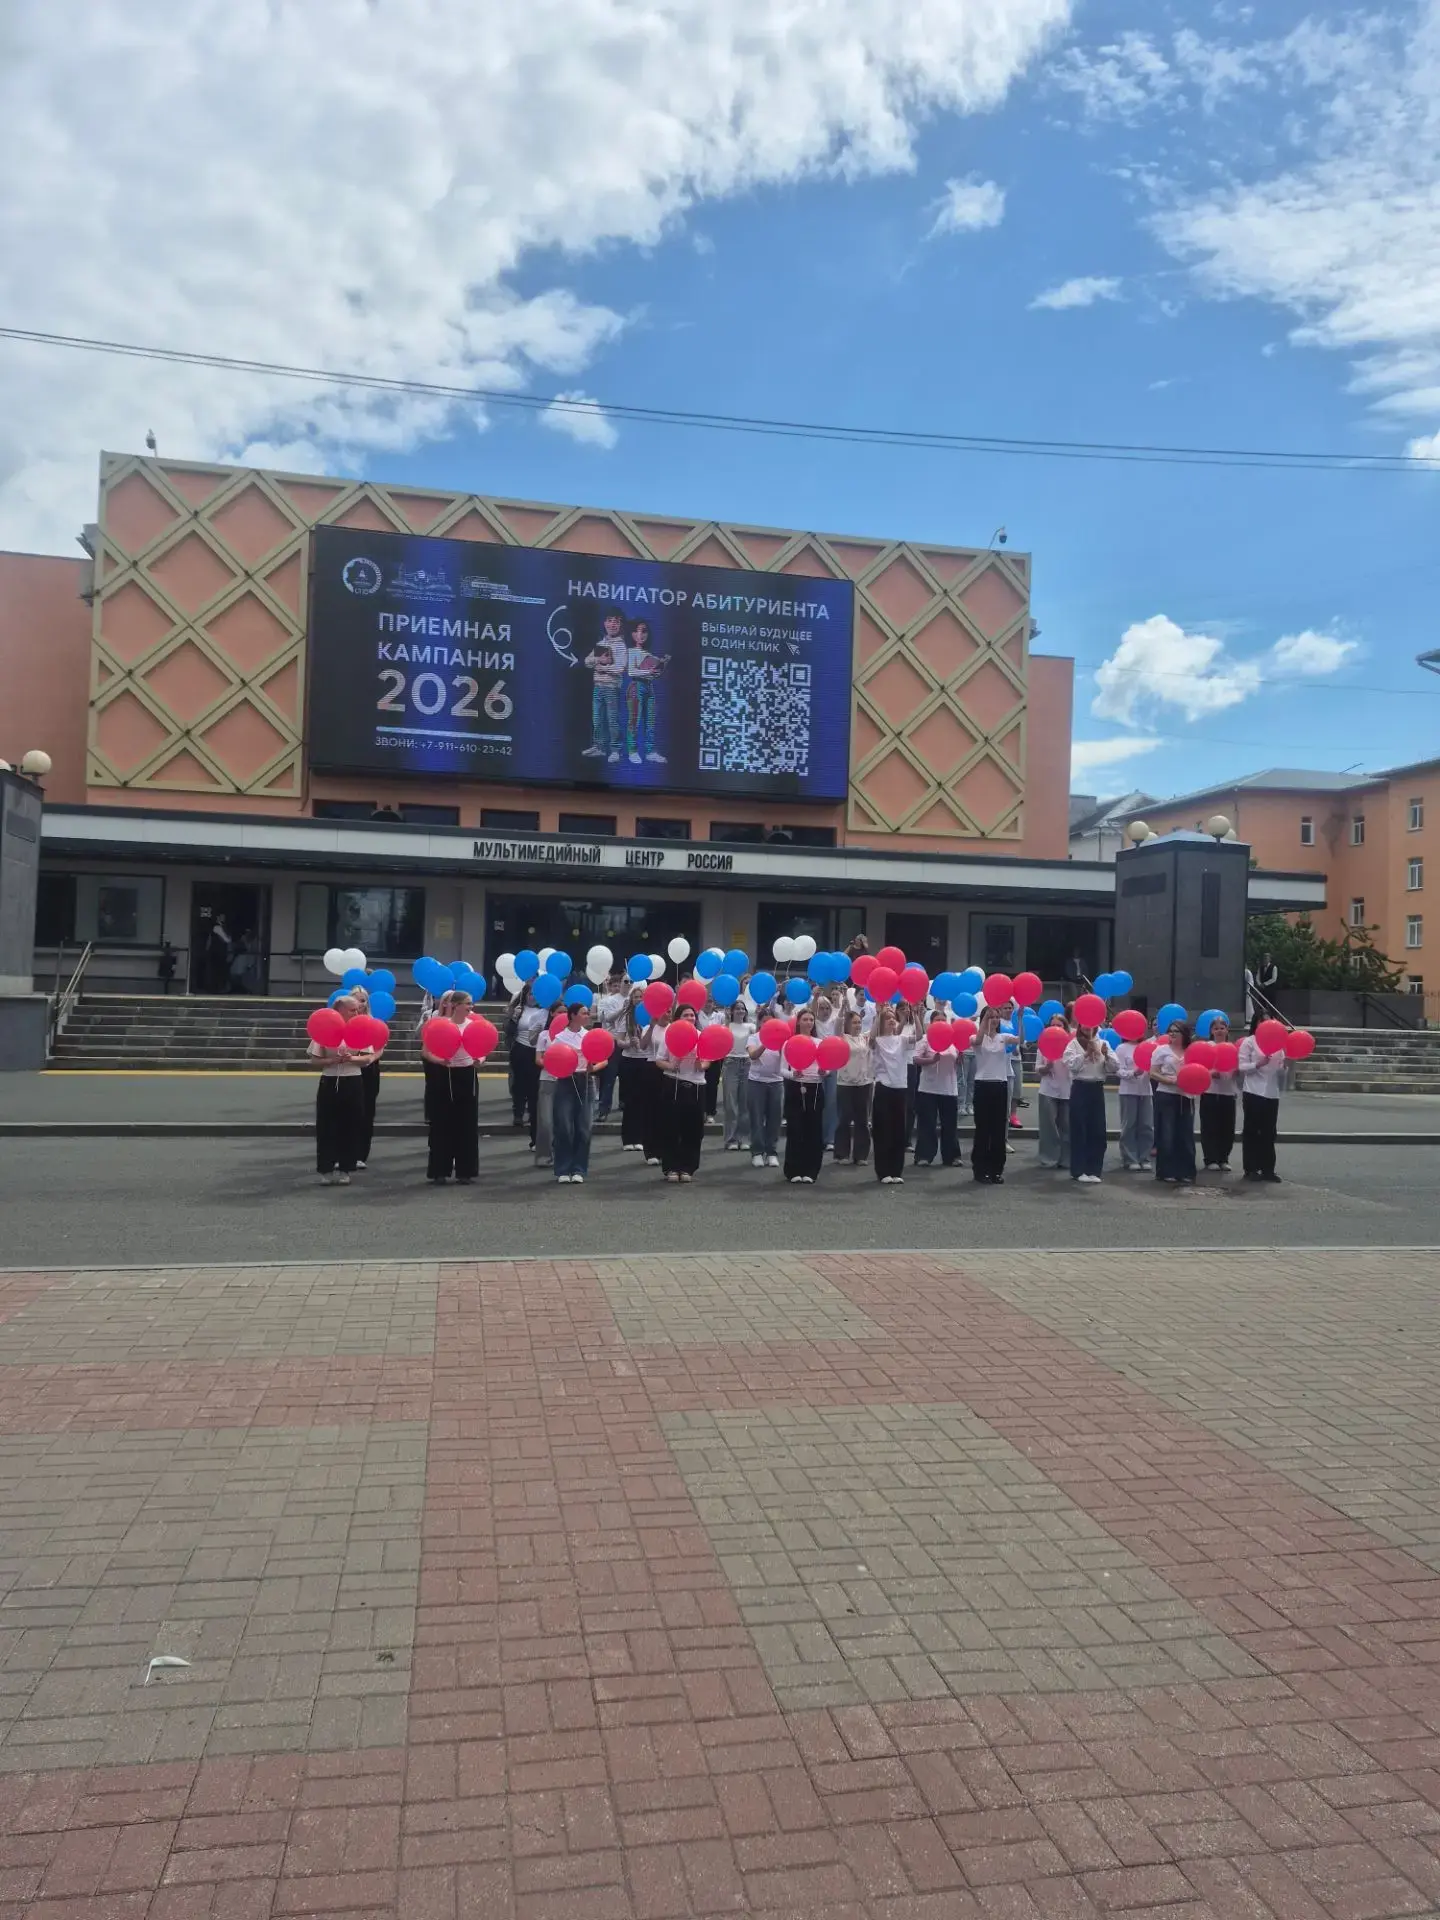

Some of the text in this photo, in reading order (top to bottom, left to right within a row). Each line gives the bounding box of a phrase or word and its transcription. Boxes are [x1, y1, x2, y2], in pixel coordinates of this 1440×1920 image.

[567, 579, 687, 606] НАВИГАТОР
[692, 592, 830, 620] АБИТУРИЕНТА
[378, 612, 511, 642] ПРИЕМНАЯ
[701, 622, 812, 642] ВЫБИРАЙ БУДУЩЕЕ
[377, 642, 515, 671] КАМПАНИЯ
[701, 636, 780, 653] В ОДИН КЛИК
[376, 669, 514, 720] 2026
[375, 736, 418, 749] ЗВОНИ:
[473, 841, 733, 870] МУЛЬТИМЕДИЙНЫЙ ЦЕНТР РОССИЯ
